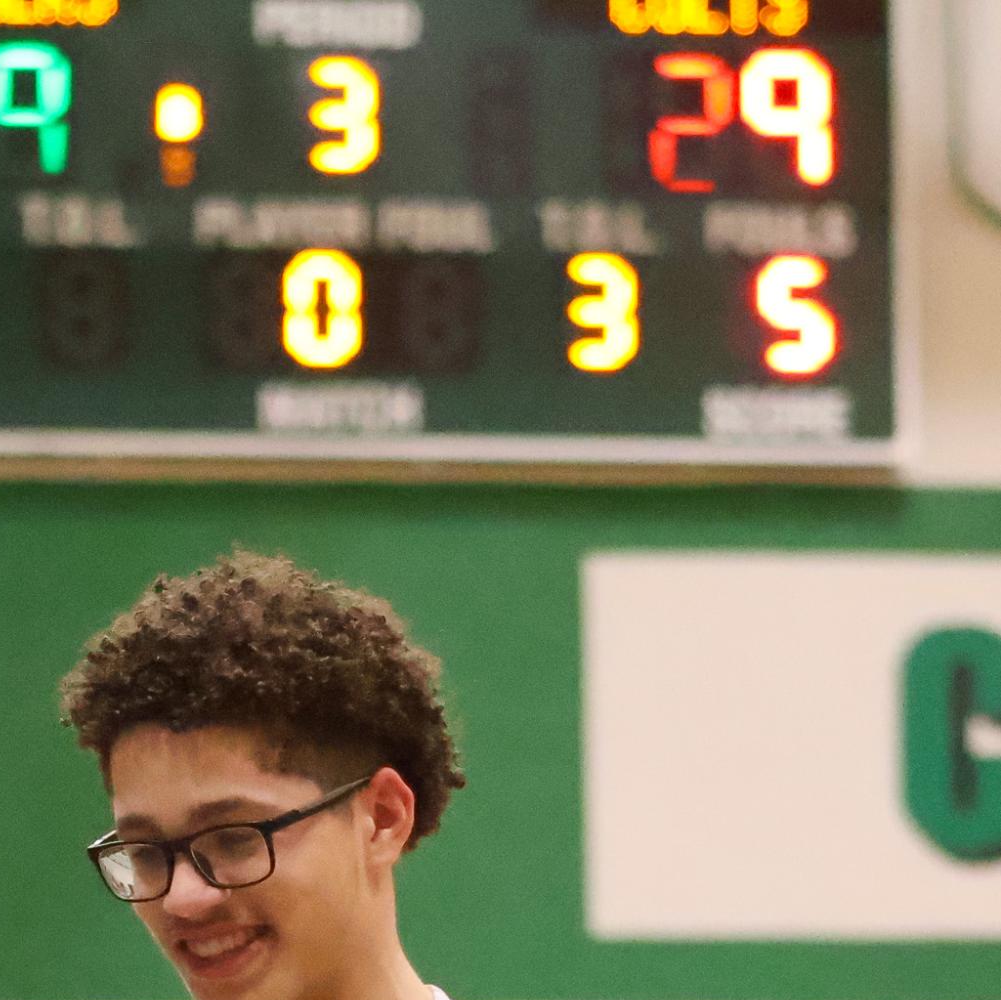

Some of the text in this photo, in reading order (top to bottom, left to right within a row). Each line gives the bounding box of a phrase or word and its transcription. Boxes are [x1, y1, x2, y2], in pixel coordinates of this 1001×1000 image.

[307, 54, 382, 176] 3
[648, 46, 835, 194] 29
[280, 247, 365, 370] 0
[565, 250, 641, 373] 3
[754, 253, 838, 379] 5
